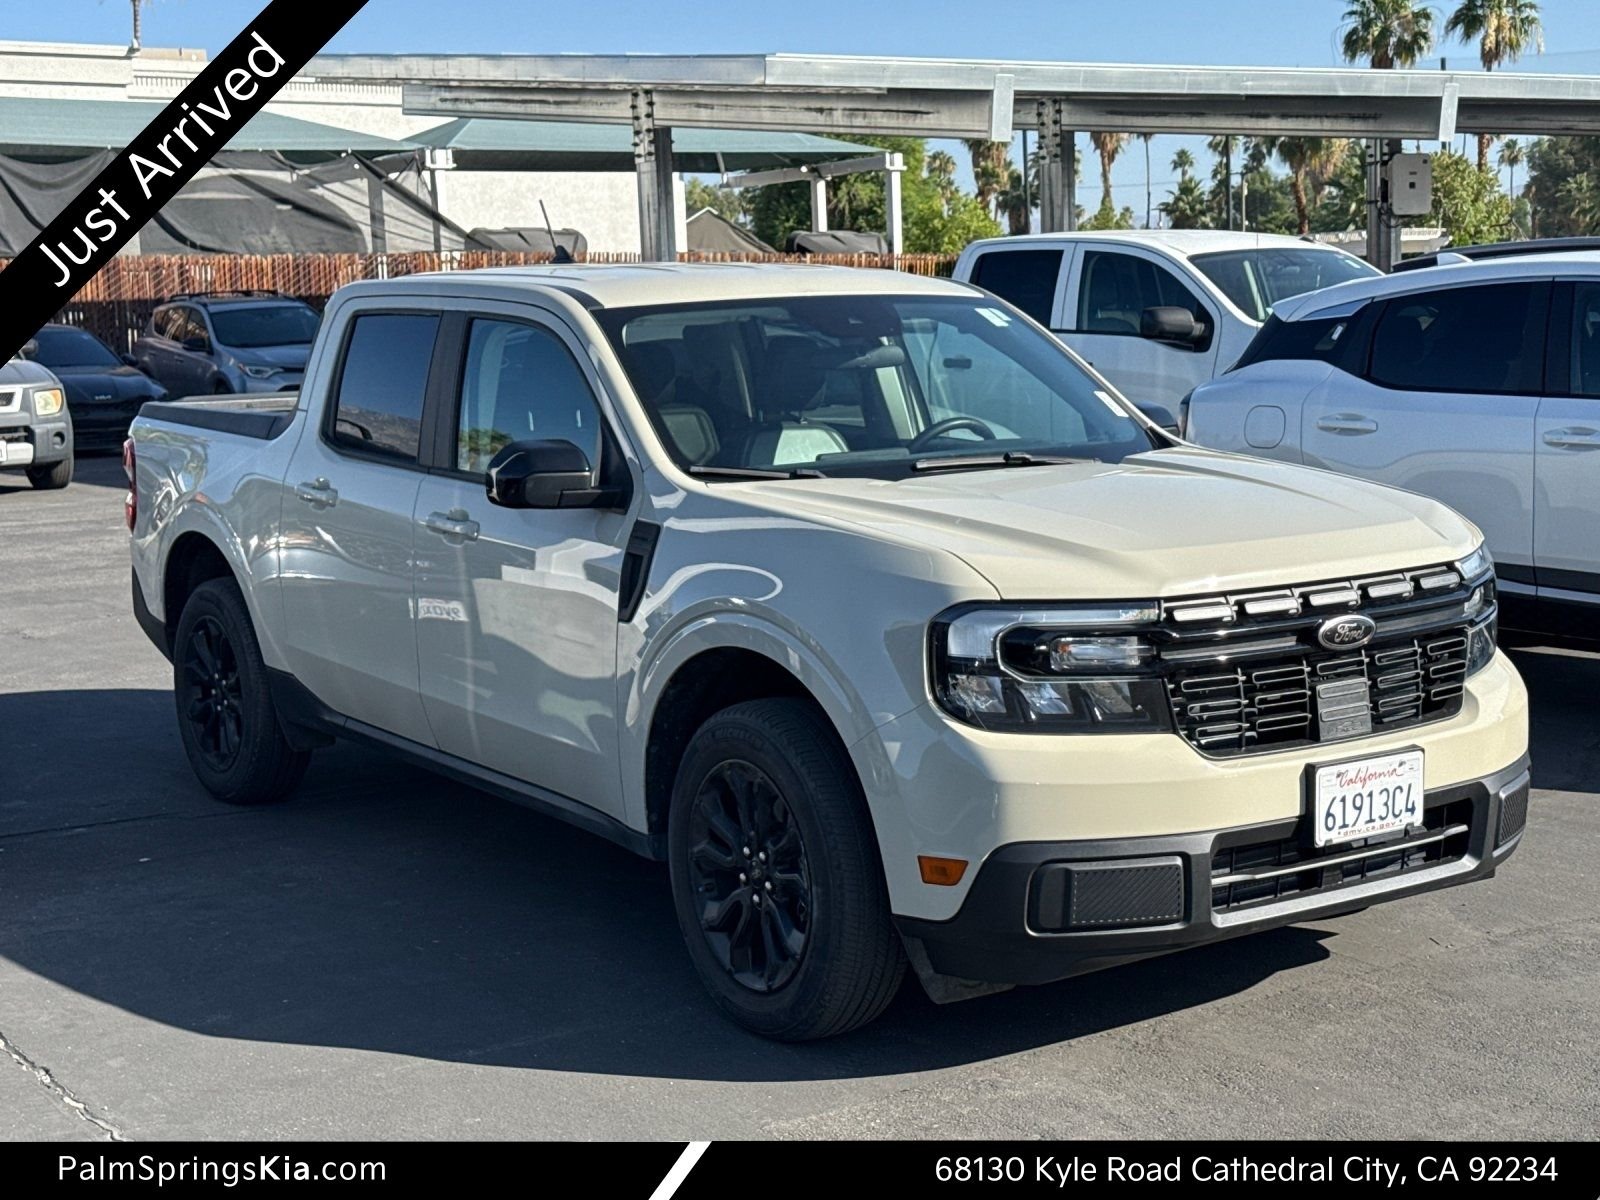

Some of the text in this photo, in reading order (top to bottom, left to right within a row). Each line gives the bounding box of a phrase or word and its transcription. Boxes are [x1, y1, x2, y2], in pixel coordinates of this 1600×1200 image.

[1334, 622, 1365, 643] Ford
[1338, 766, 1404, 789] California
[1324, 782, 1416, 832] 61913C4
[1342, 821, 1397, 837] dmv.ca.gov
